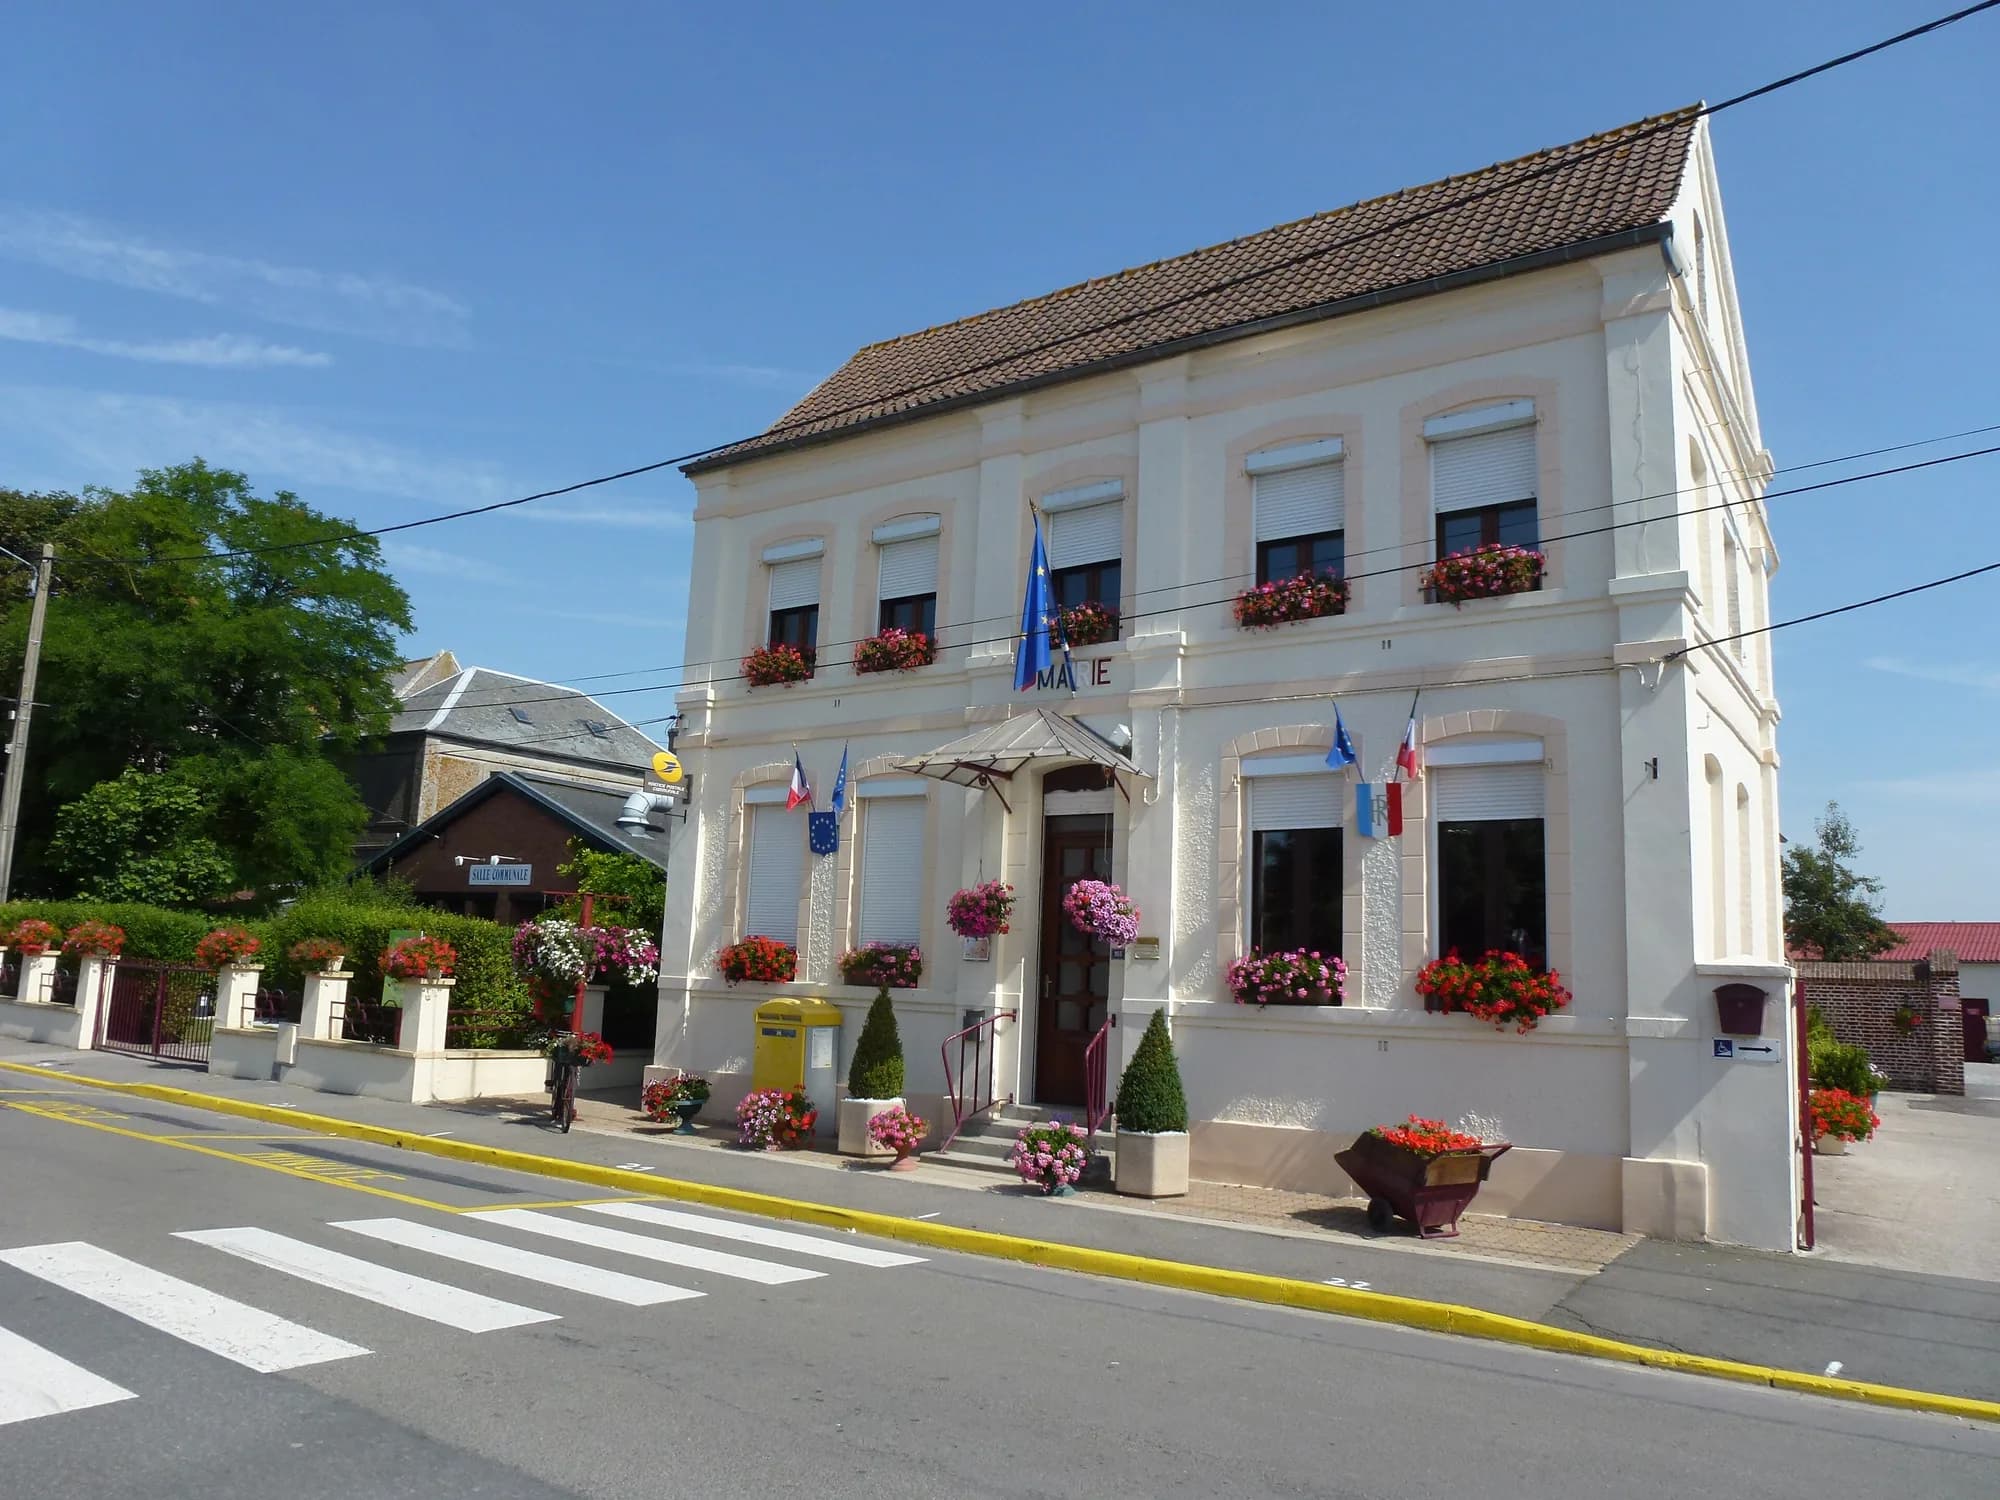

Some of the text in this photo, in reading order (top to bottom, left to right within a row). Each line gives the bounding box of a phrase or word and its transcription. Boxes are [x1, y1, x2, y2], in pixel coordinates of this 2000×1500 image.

[1037, 658, 1112, 691] MARIE
[472, 867, 529, 881] SALLE COMMUNALE
